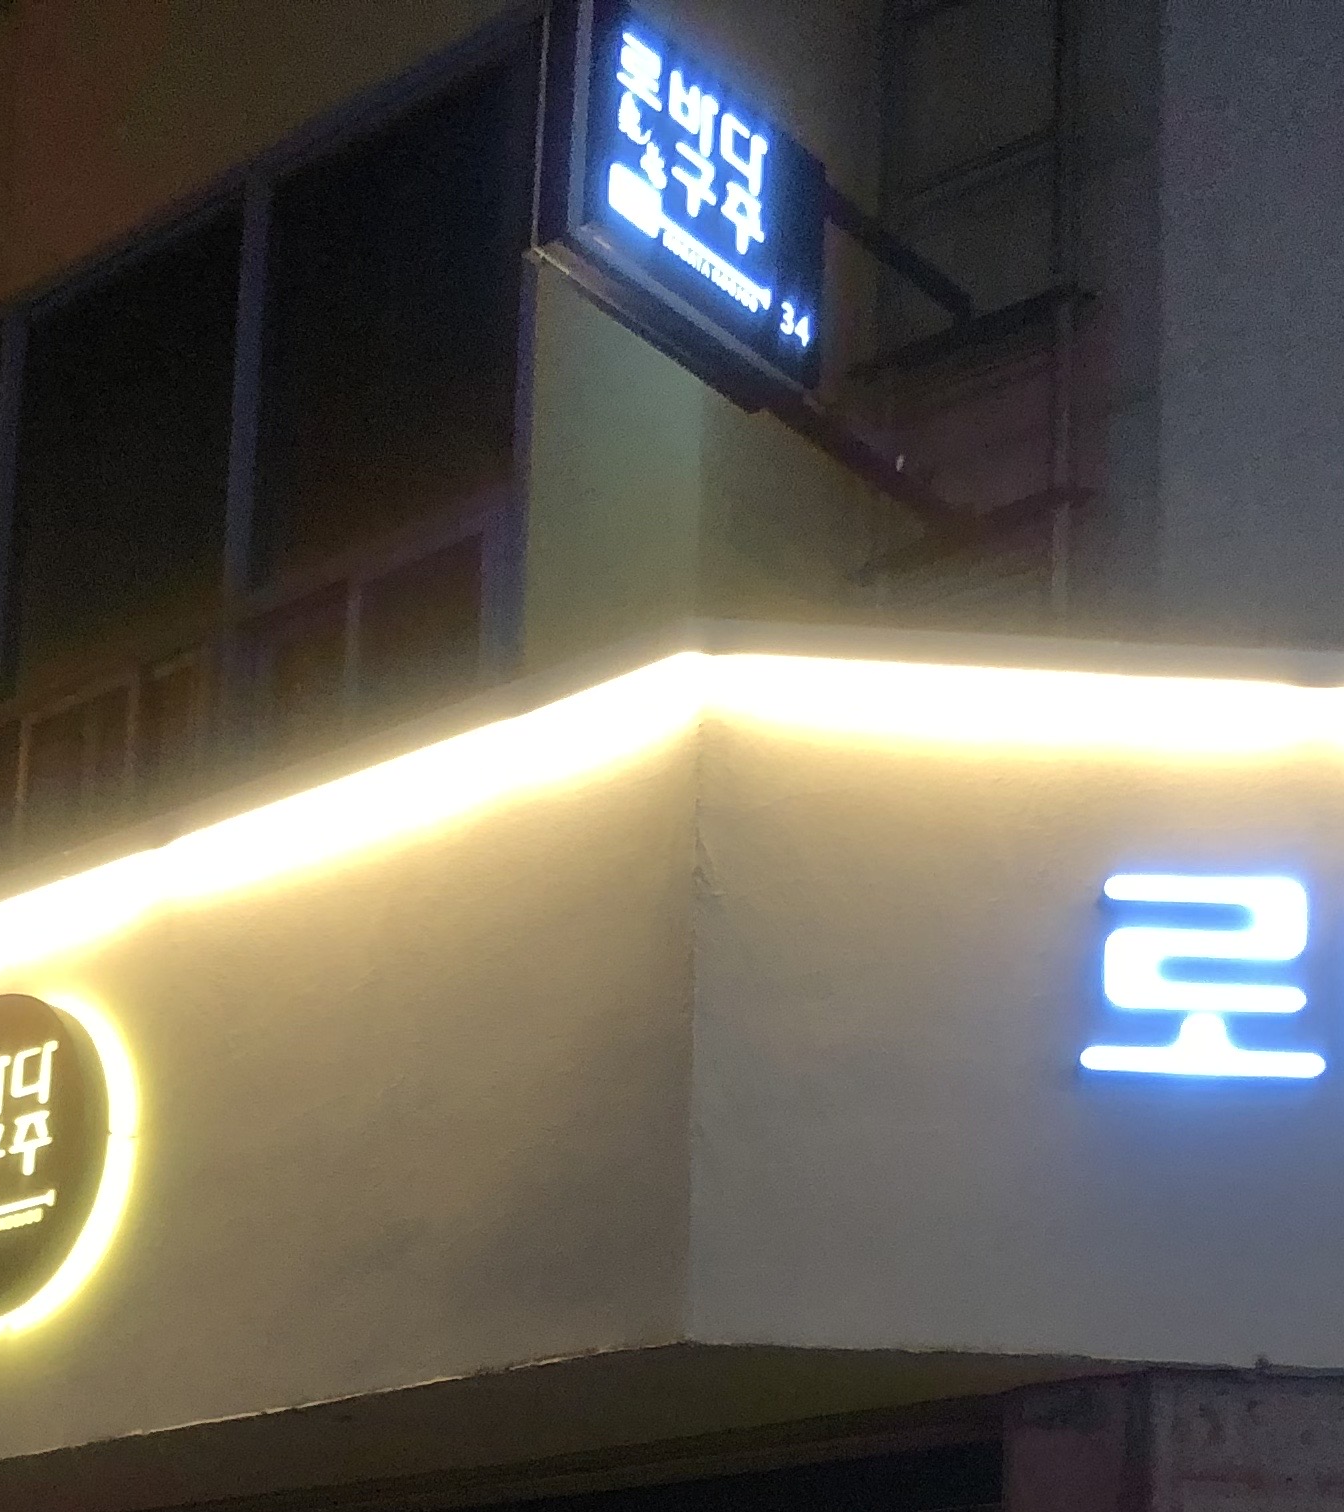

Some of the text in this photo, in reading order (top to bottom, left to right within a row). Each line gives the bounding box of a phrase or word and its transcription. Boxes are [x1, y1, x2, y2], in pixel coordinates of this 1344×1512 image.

[616, 31, 769, 197] 로바다
[671, 141, 765, 255] 구주
[780, 301, 811, 347] 34
